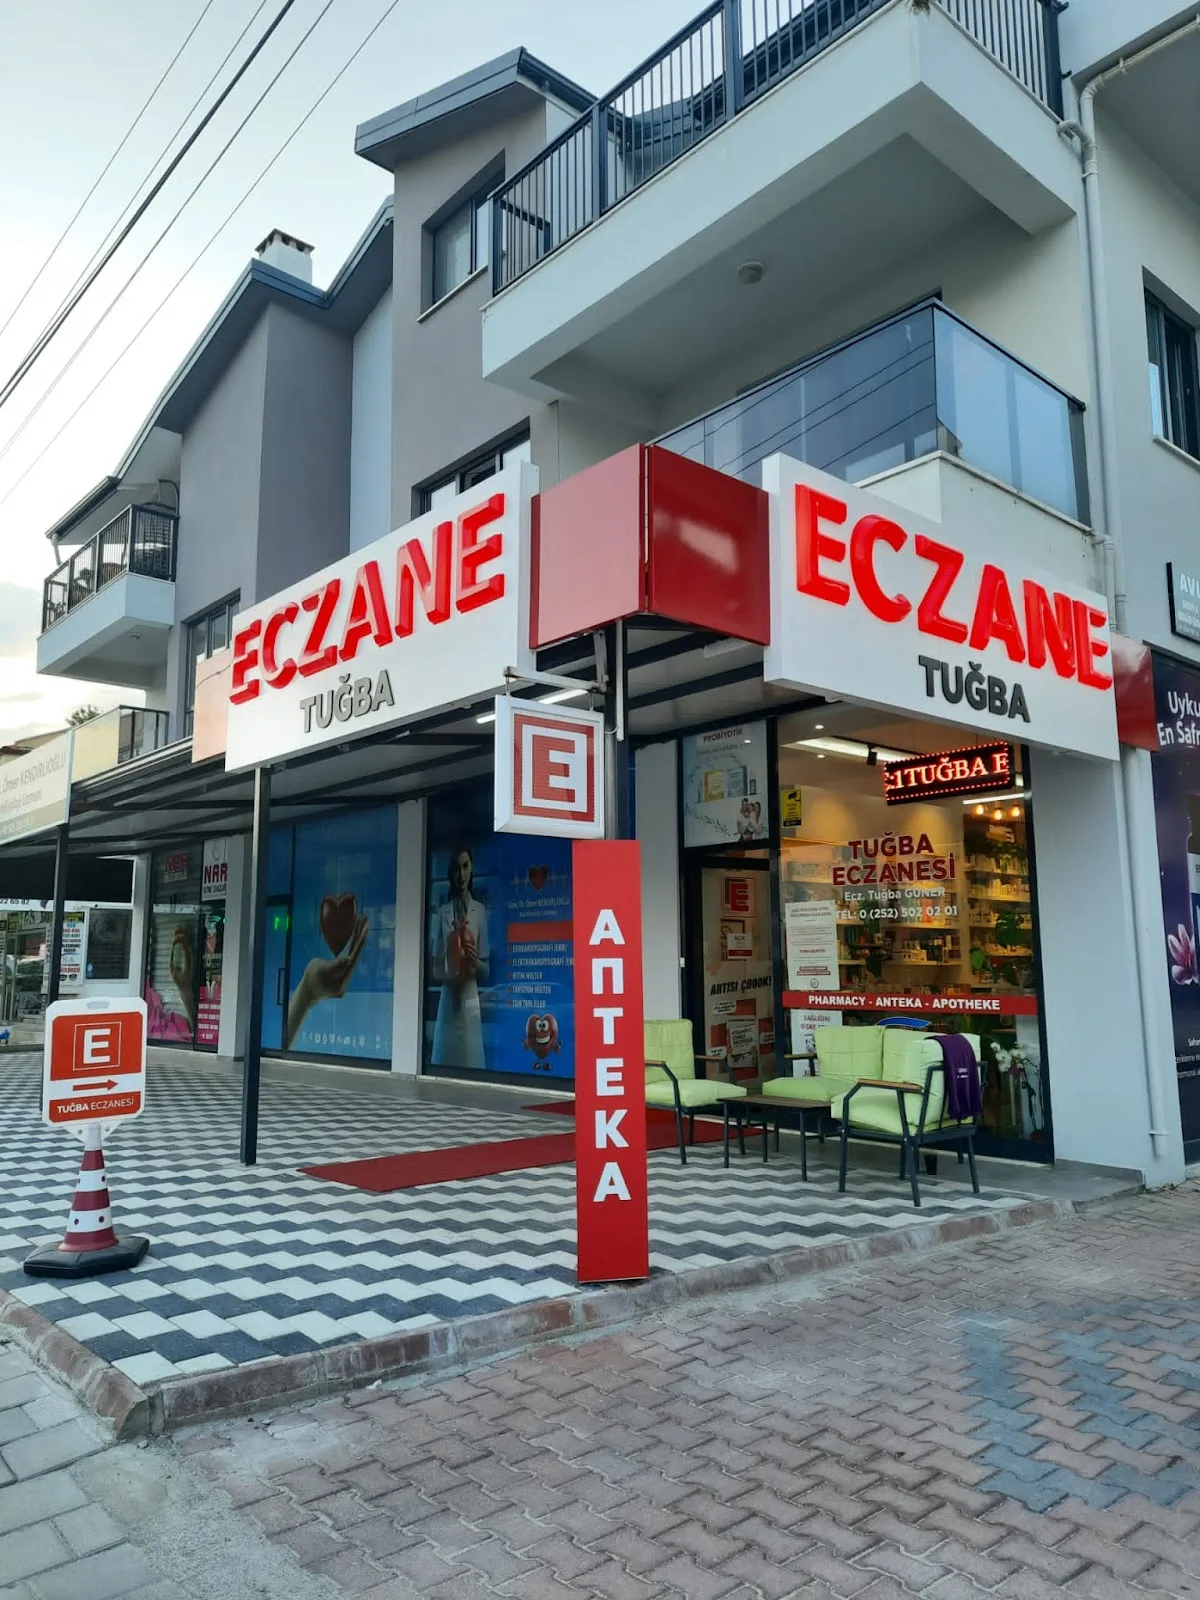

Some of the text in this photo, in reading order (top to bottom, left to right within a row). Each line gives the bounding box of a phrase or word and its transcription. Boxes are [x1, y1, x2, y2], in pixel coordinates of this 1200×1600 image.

[229, 493, 505, 706] ECZANE
[795, 483, 1112, 691] ECZANE
[300, 668, 394, 733] TUĞBA
[919, 655, 1031, 723] TUĞBA
[1157, 722, 1175, 746] En
[532, 734, 575, 803] E
[848, 831, 934, 859] TUĞBA
[204, 863, 228, 884] NAR
[832, 852, 956, 886] ECZANESİ
[868, 889, 902, 901] Tuğba
[859, 909, 867, 919] 0
[869, 907, 899, 920] (252)
[926, 906, 941, 916] 02
[944, 905, 958, 916] 01
[808, 995, 1001, 1010] PHARMACY ANTEKA APOTHEKE
[83, 1028, 111, 1064] E
[588, 908, 633, 1203] АПТЕКА
[57, 1098, 135, 1114] TUĞBA ECZANESİ
